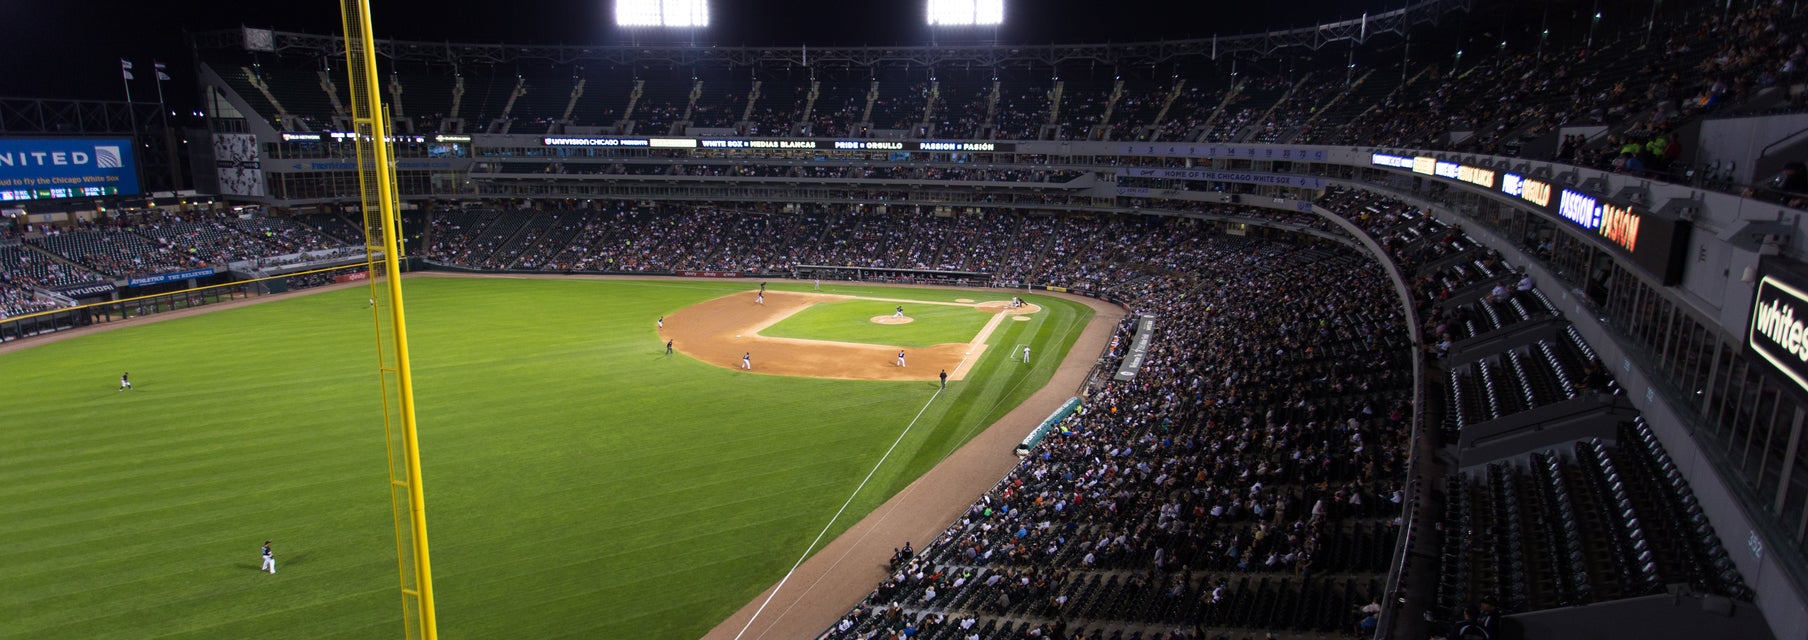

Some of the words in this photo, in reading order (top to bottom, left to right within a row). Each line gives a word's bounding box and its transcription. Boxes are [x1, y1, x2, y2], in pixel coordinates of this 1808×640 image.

[750, 140, 778, 148] MEDIAS
[920, 142, 955, 150] PASSION
[963, 142, 994, 151] PASIÓN
[37, 177, 50, 185] the
[52, 176, 82, 184] Chicago
[1559, 187, 1597, 229] PASSION
[1599, 203, 1640, 253] PASIÓN
[131, 275, 165, 285] ATHLETICO
[181, 269, 213, 279] BELIEVERS
[66, 284, 114, 296] HYUNDAI
